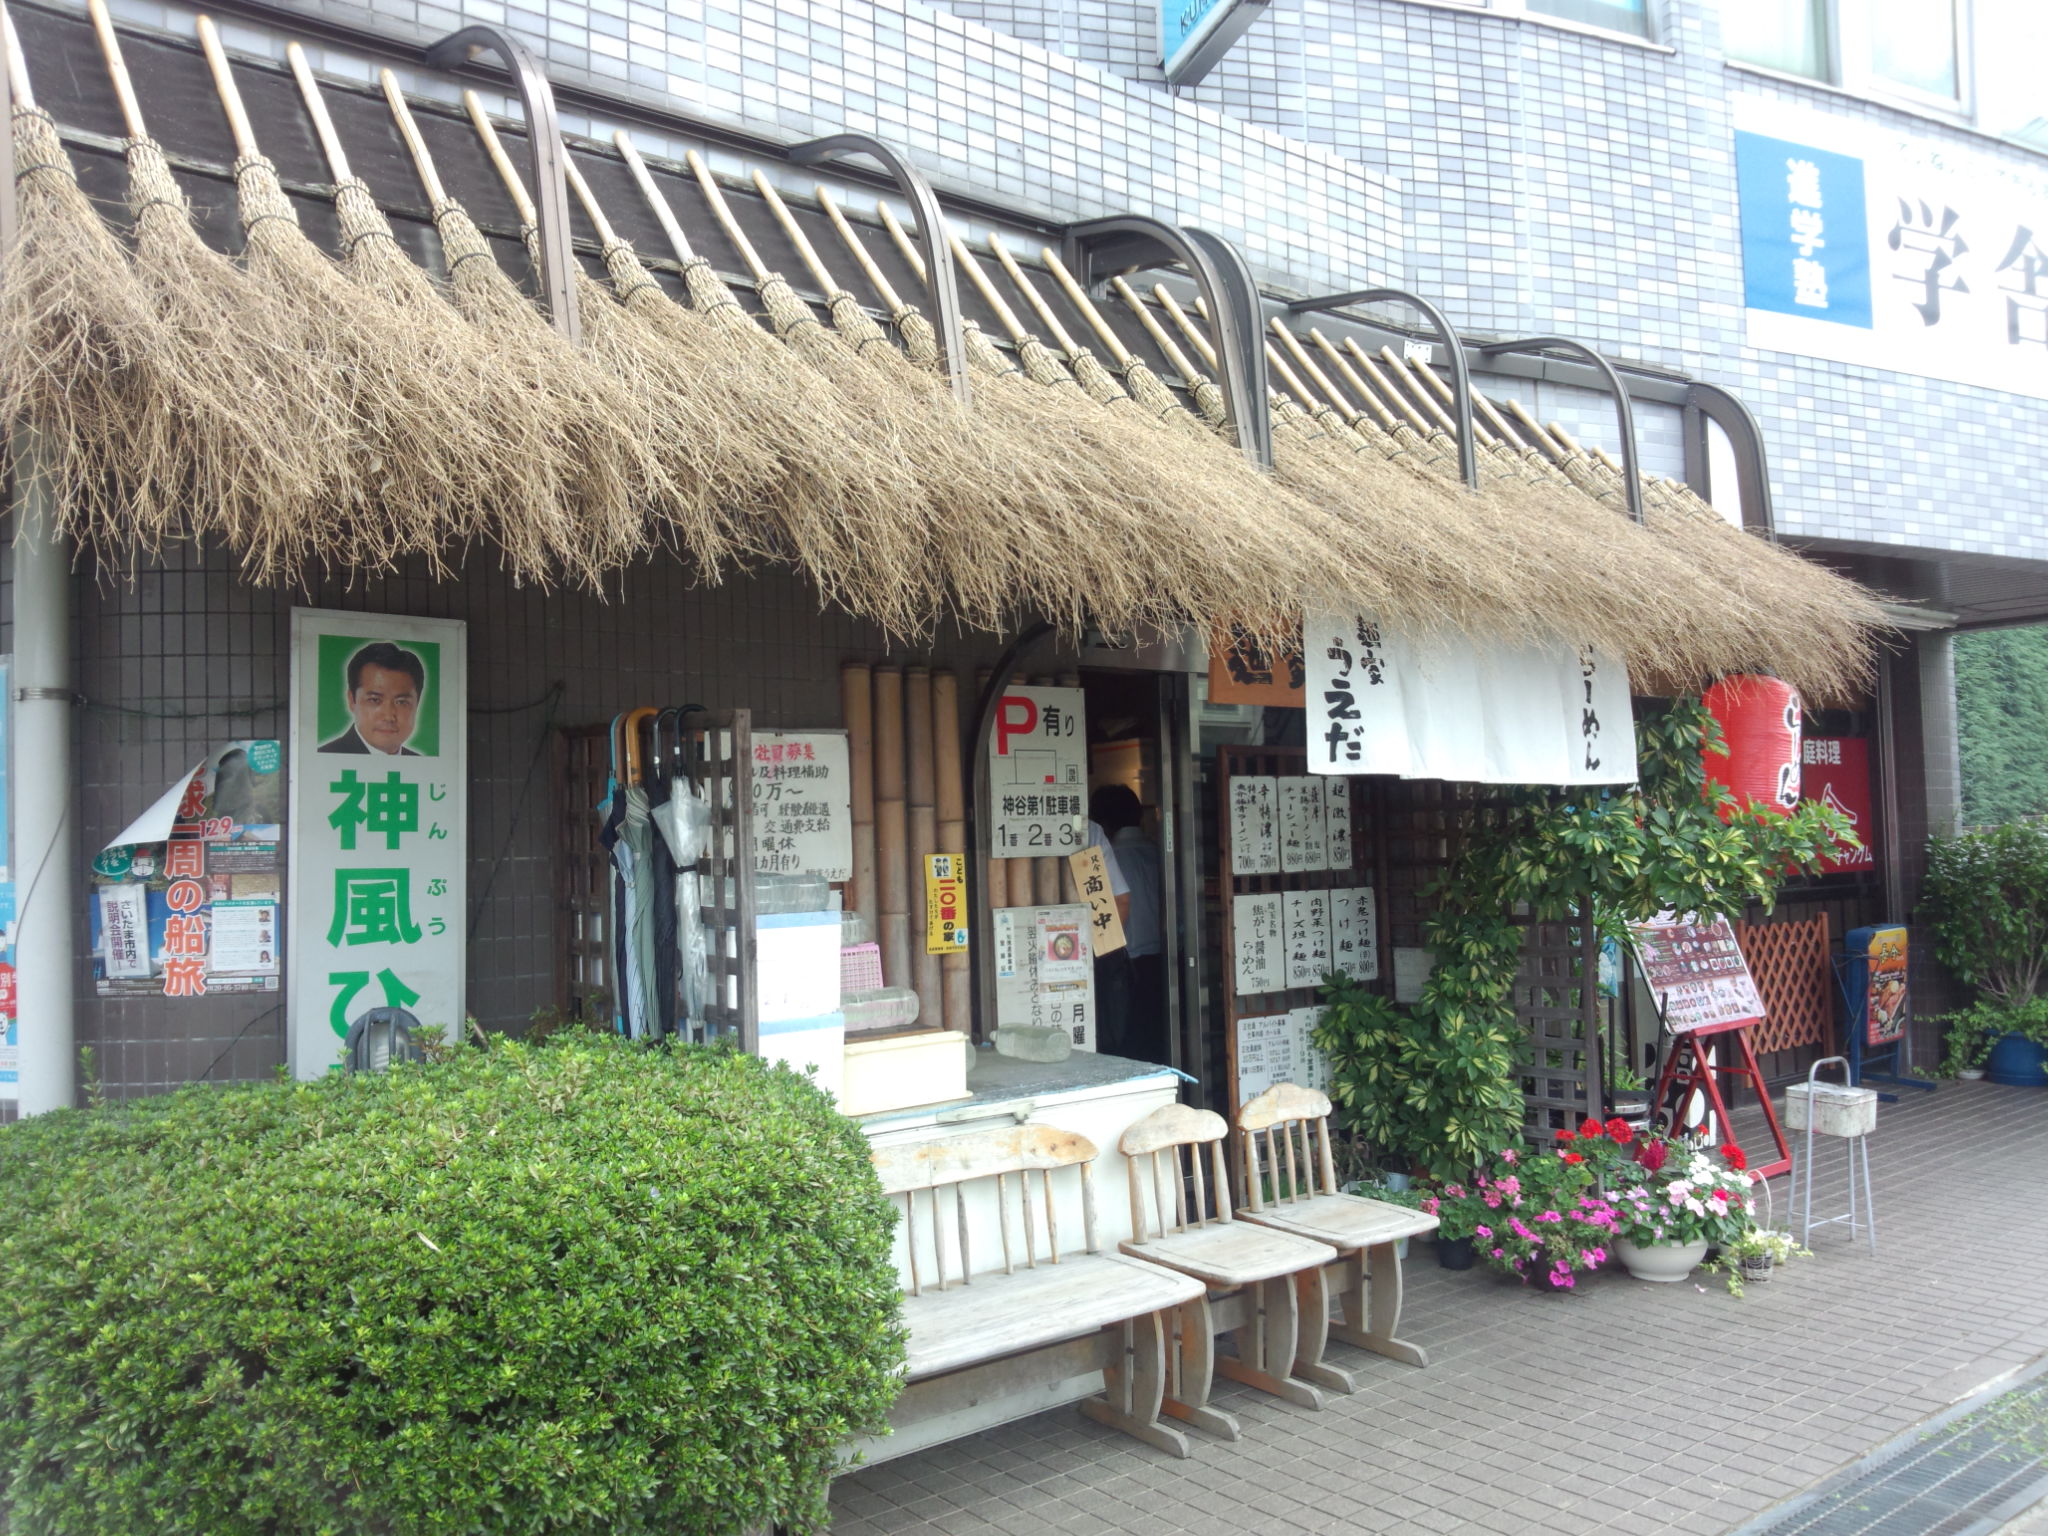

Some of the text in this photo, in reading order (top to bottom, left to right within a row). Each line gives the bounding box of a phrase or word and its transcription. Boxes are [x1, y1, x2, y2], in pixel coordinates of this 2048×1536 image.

[1786, 157, 1828, 309] 進学塾
[996, 695, 1075, 755] P 有り
[1323, 636, 1365, 763] うえだ
[1578, 643, 1601, 771] らーめん
[754, 742, 816, 762] 社員募集
[200, 817, 233, 838] 129
[765, 818, 830, 834] 交通費支給
[1002, 795, 1081, 816] 神谷第1駐車場
[1285, 786, 1301, 848] チャーシュー麺
[1083, 874, 1114, 930] 商い中
[1311, 897, 1327, 959] 肉野菜つけ麺
[1337, 898, 1354, 953] つけ麺
[120, 900, 137, 969] さいたま市内で
[1072, 1003, 1086, 1045] 月曜
